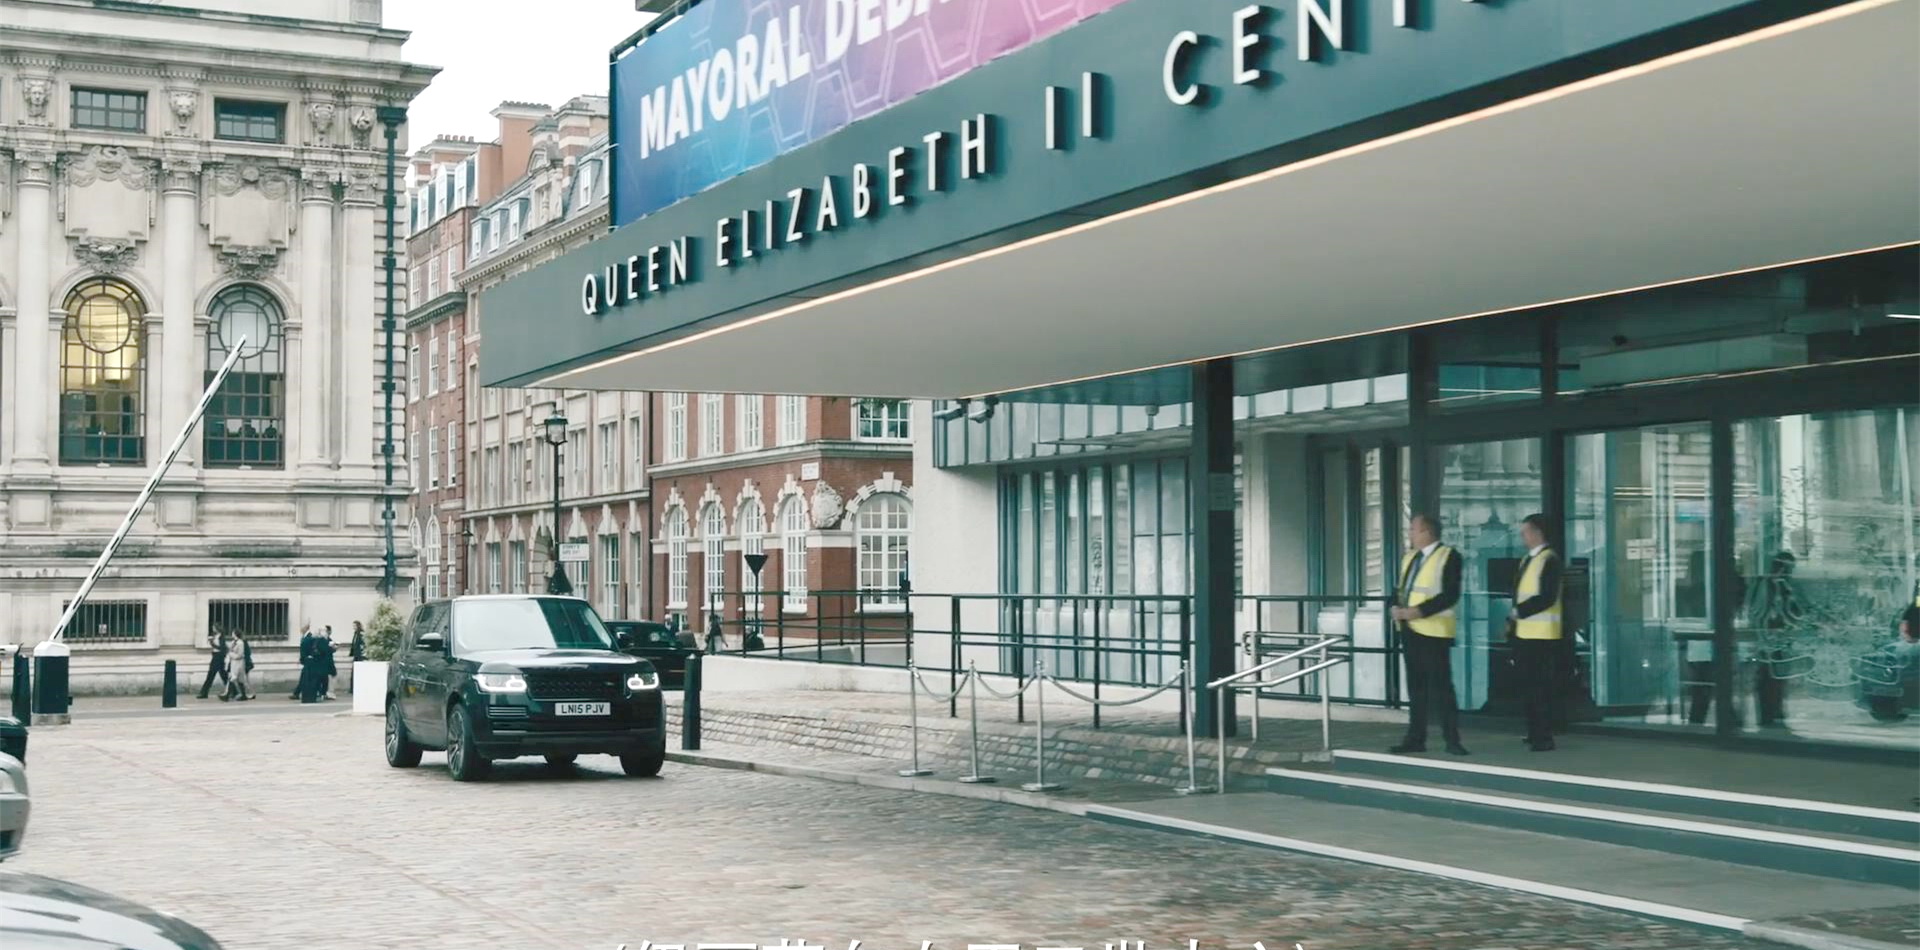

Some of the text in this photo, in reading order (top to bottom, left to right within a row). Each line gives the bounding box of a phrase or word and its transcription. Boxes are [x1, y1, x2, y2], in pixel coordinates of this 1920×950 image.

[582, 0, 1475, 315] QUEEN ELIZABETH II CEN
[640, 5, 811, 159] MAYORAL
[561, 704, 605, 714] LN15 PJV
